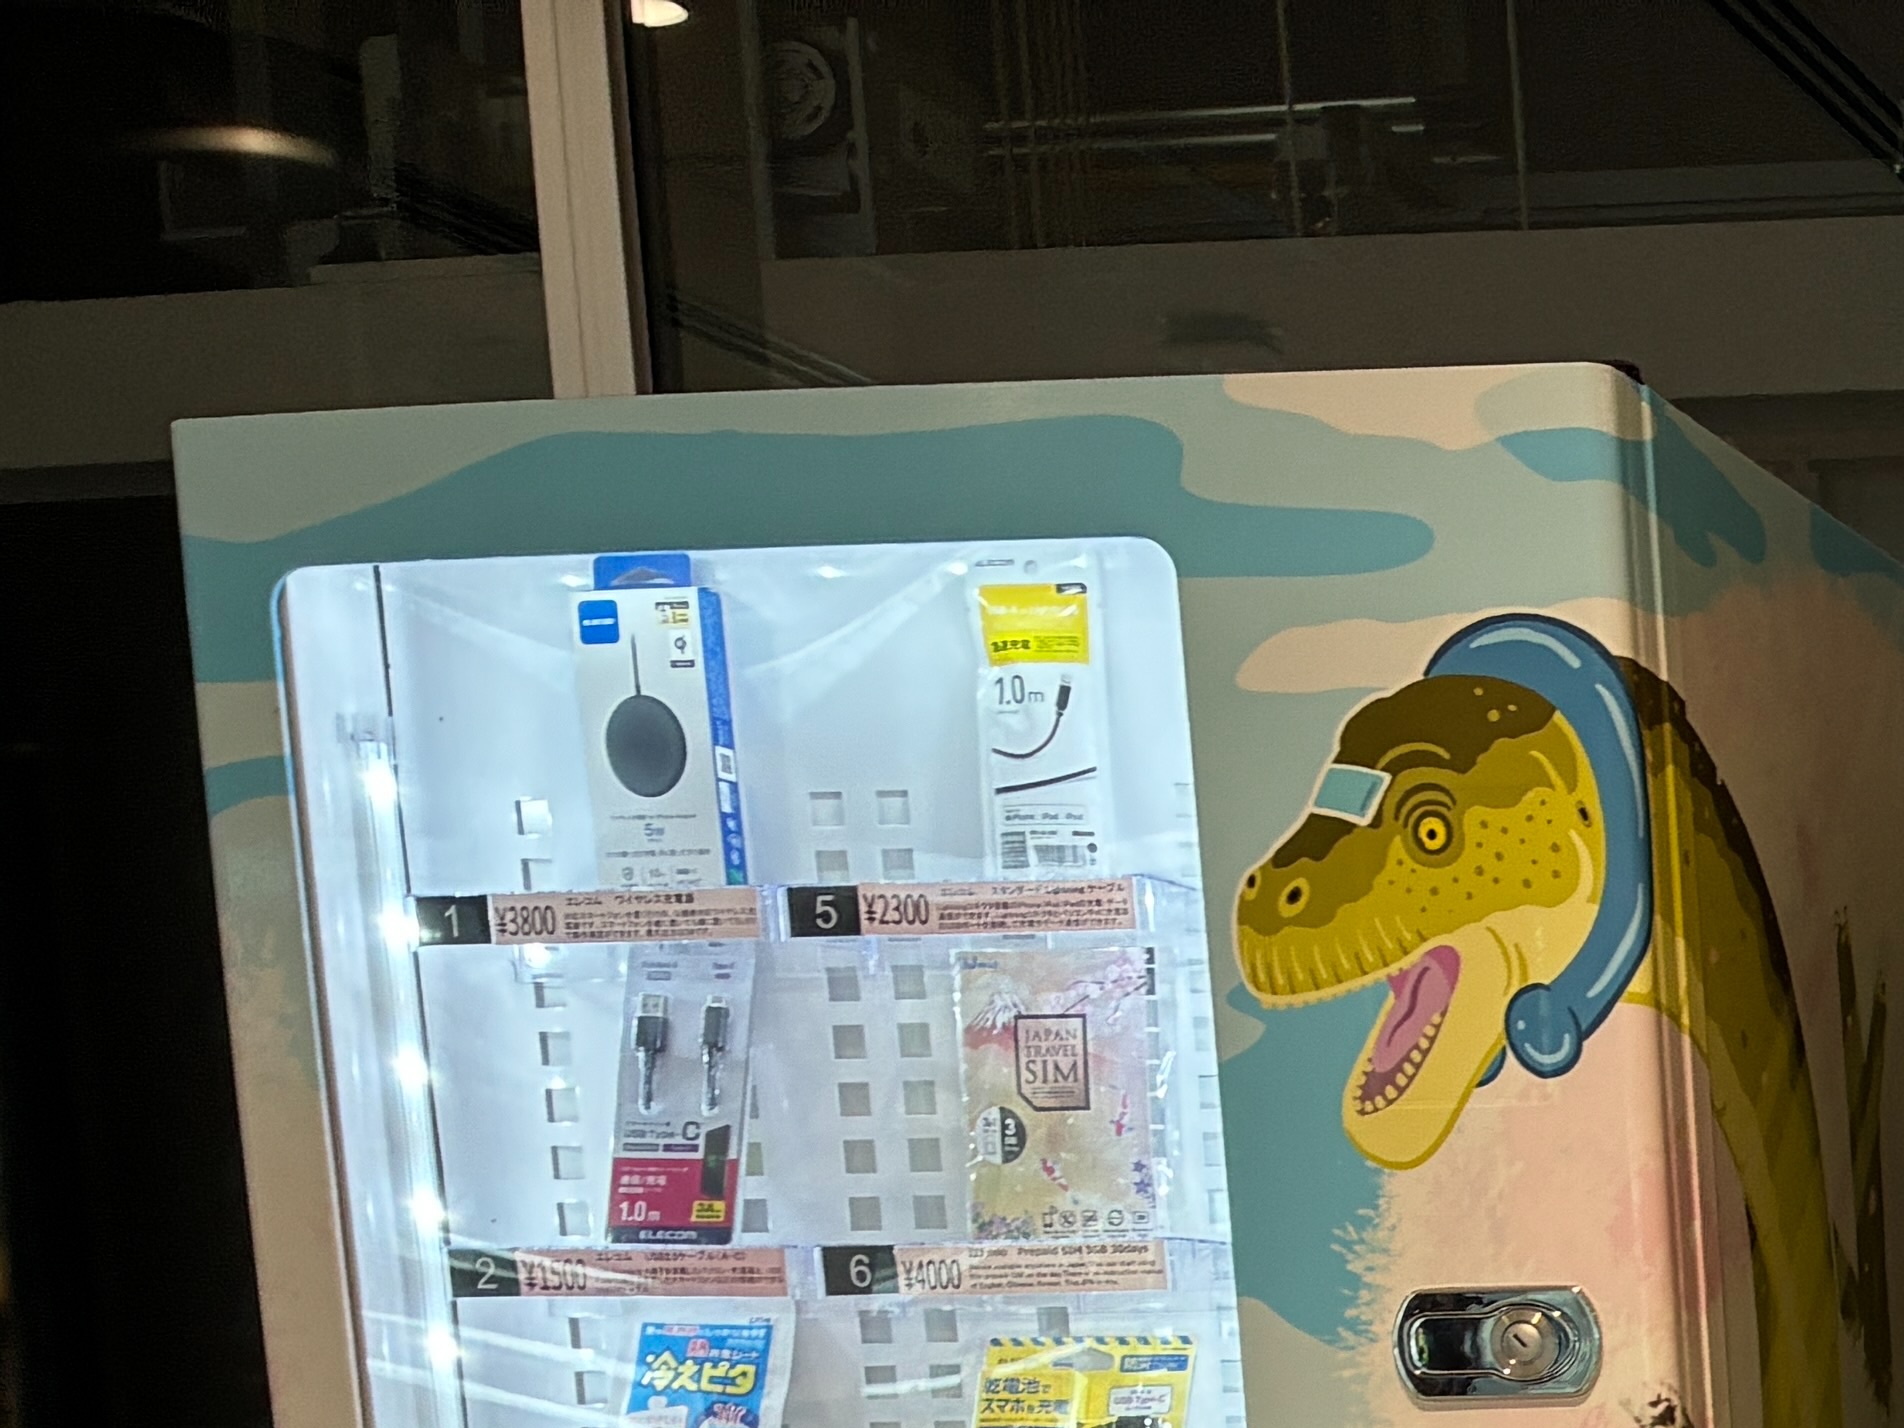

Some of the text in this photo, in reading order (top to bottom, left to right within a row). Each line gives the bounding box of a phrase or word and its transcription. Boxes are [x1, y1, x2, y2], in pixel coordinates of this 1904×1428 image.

[1025, 1029, 1078, 1043] JAPAN
[1025, 1045, 1078, 1058] TRAVEL
[1025, 1060, 1079, 1084] SIM
[641, 1350, 757, 1395] 冷えピタ
